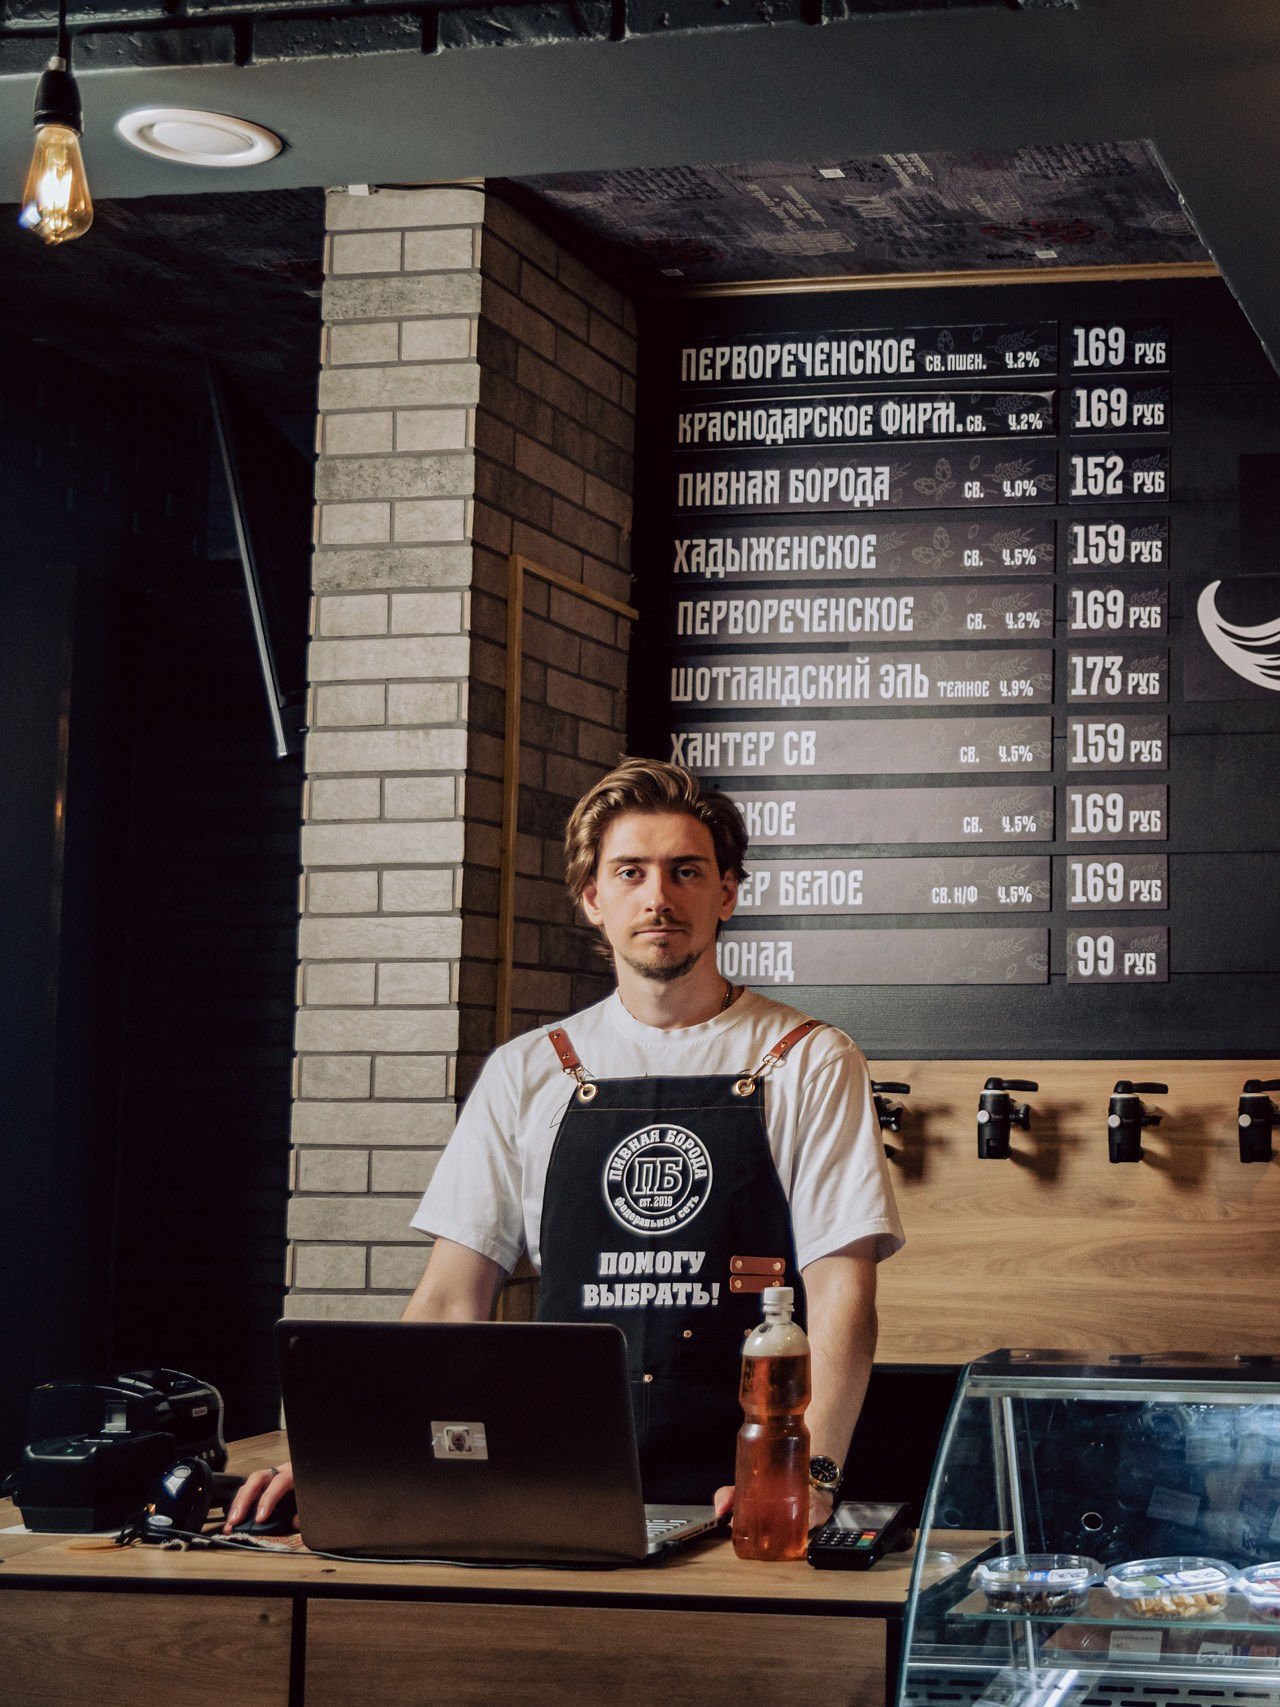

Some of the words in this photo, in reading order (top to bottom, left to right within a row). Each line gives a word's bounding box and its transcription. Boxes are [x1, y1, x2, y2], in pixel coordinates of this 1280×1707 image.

[682, 339, 915, 381] ПЕРВОРЕЧЕНСКОЕ
[1006, 352, 1039, 368] 4.2%
[1074, 327, 1125, 366] 169
[1135, 343, 1165, 364] РУБ
[680, 405, 873, 444] КРАСНОДАРСКОЕ
[881, 402, 963, 434] ФИРМ.
[967, 416, 986, 432] СВ.
[1009, 413, 1042, 430] 4.2%
[1076, 388, 1127, 427] 169
[1133, 404, 1164, 425] РУБ
[679, 470, 780, 506] ПИВНАЯ
[789, 467, 889, 507] БОРОДА
[965, 482, 984, 498] СВ.
[1003, 480, 1036, 497] 4.0%
[1072, 456, 1123, 495] 152
[1134, 472, 1164, 493] РУБ
[674, 534, 876, 577] ХАДЫЖЕНСКОЕ
[964, 550, 983, 566] СВ.
[1003, 549, 1036, 565] 4.5%
[1073, 525, 1125, 564] 159
[1131, 541, 1162, 562] РУБ
[678, 597, 913, 635] ПЕРВОРЕЧЕНСКОЕ
[967, 614, 986, 630] СВ.
[1006, 612, 1040, 629] 4.2%
[1072, 590, 1124, 629] 169
[1130, 607, 1160, 628] РУБ
[671, 657, 869, 706] ШОТЛАНДСКИЙ
[880, 664, 929, 698] ЭЛЬ
[938, 681, 989, 697] ТЕМНОЕ
[1000, 680, 1033, 696] 4.9%
[1071, 656, 1123, 695] 173
[1128, 673, 1159, 694] РУБ
[671, 731, 774, 766] ХАНТЕР
[784, 731, 816, 765] СВ
[960, 747, 979, 762] СВ.
[999, 746, 1032, 762] 4.5%
[1072, 723, 1124, 763] 159
[1131, 741, 1161, 762] РУБ
[964, 817, 982, 833] СВ.
[1002, 816, 1036, 832] 4.5%
[1071, 793, 1123, 833] 169
[1130, 811, 1160, 832] РУБ
[780, 870, 863, 905] БЕЛОЕ
[998, 886, 1032, 903] 4.5%
[1071, 863, 1123, 902] 169
[1130, 880, 1161, 901] РУБ
[1077, 936, 1114, 975] 99
[1124, 953, 1156, 974] РУБ
[609, 1129, 660, 1181] ПИВНАЯ
[665, 1130, 707, 1179] БОРОДА
[633, 1157, 684, 1195] ПБ
[678, 1195, 699, 1216] сеть
[600, 1251, 705, 1274] ПОМОГУ
[584, 1283, 720, 1306] ВЫБРАТЬ!
